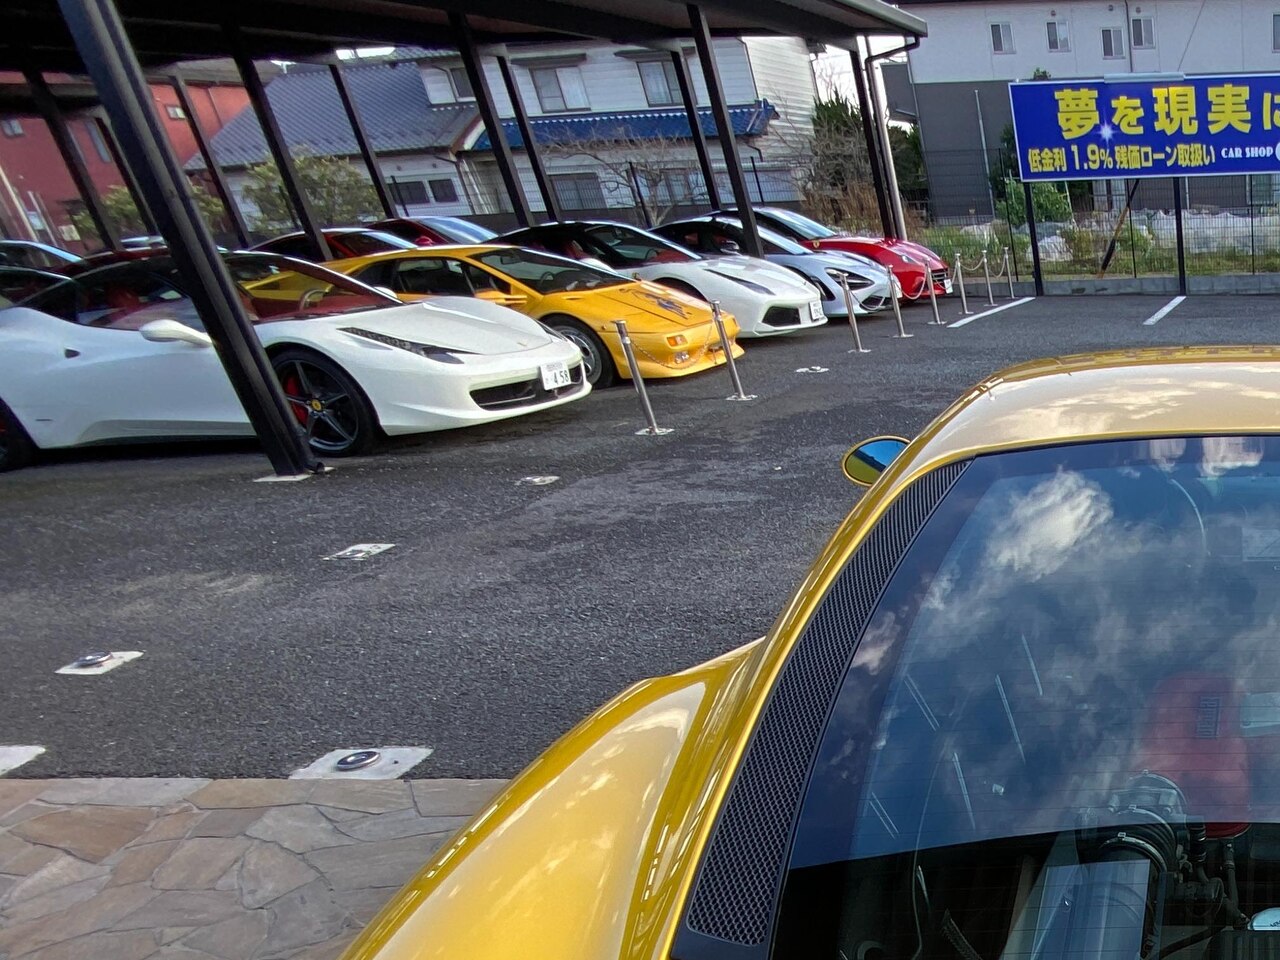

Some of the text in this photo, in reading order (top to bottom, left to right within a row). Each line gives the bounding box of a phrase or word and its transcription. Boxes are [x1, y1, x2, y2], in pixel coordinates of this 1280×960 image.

[1028, 143, 1216, 173] 低金利 1.9% 残価ローン取扱い
[1220, 147, 1243, 158] CAR
[1244, 146, 1274, 158] SHOP
